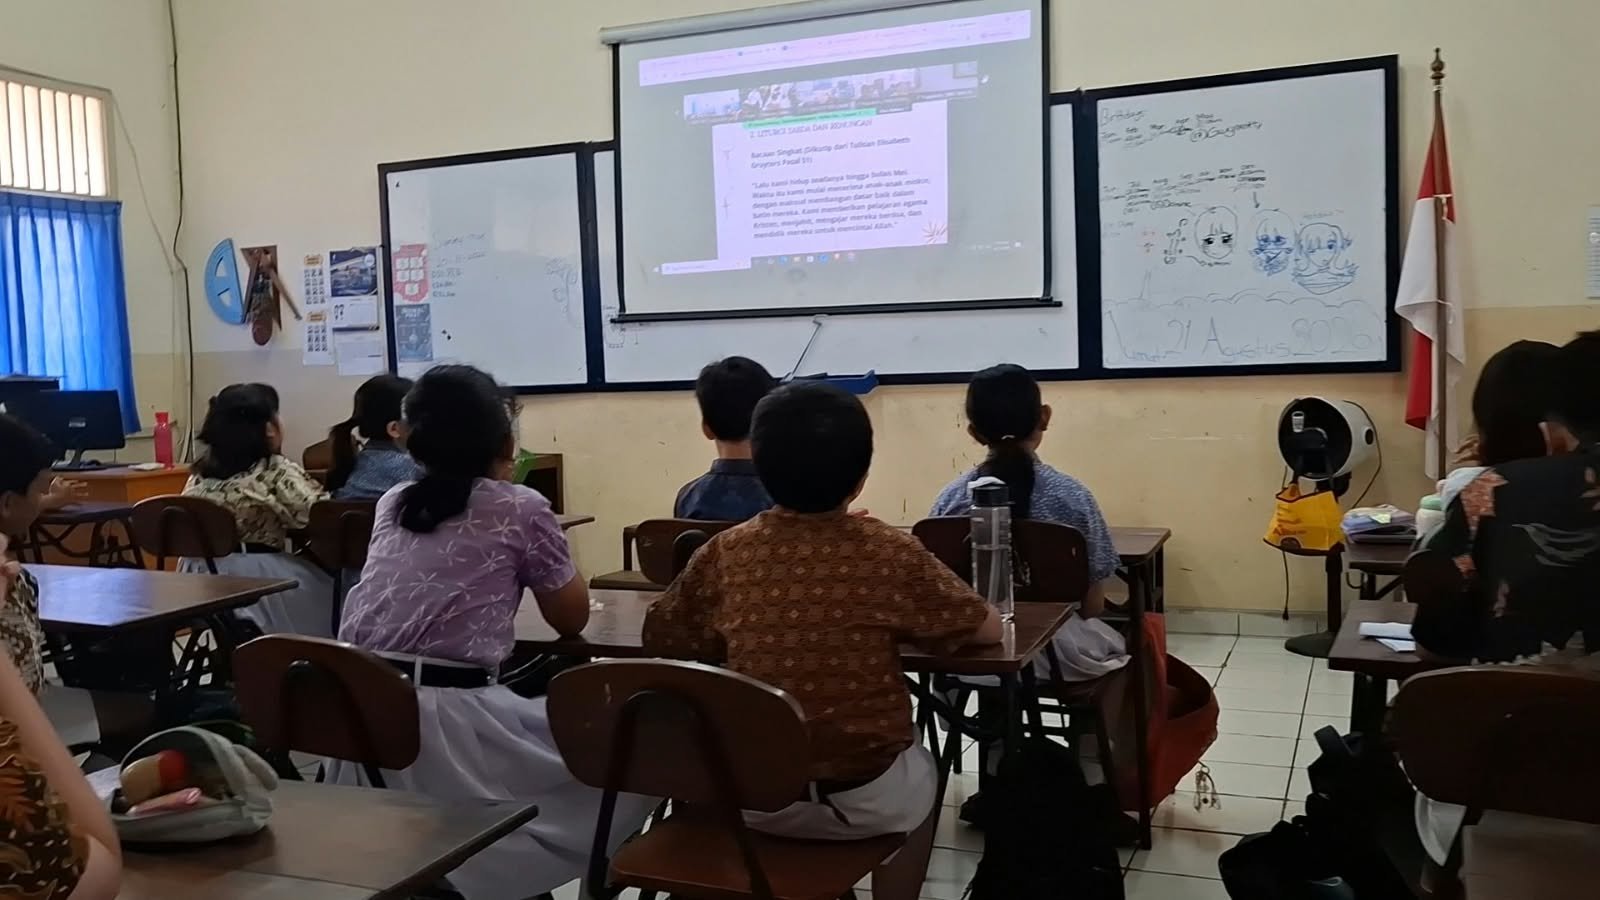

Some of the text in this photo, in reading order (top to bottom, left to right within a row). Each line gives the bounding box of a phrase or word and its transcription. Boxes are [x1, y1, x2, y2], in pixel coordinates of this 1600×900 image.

[812, 124, 828, 132] DAN
[776, 148, 802, 156] Singkat
[789, 178, 809, 186] hidup
[845, 173, 869, 181] hingga
[827, 184, 864, 192] menerima
[865, 181, 902, 189] anak-anak
[807, 195, 852, 204] membangun
[892, 189, 915, 197] dalam
[820, 205, 866, 213] memberikan
[867, 202, 902, 211] pelajaran
[903, 199, 928, 207] agama
[815, 216, 848, 225] mengajar
[753, 230, 785, 238] mendidik
[814, 226, 835, 234] untuk
[836, 223, 873, 232] mencintai
